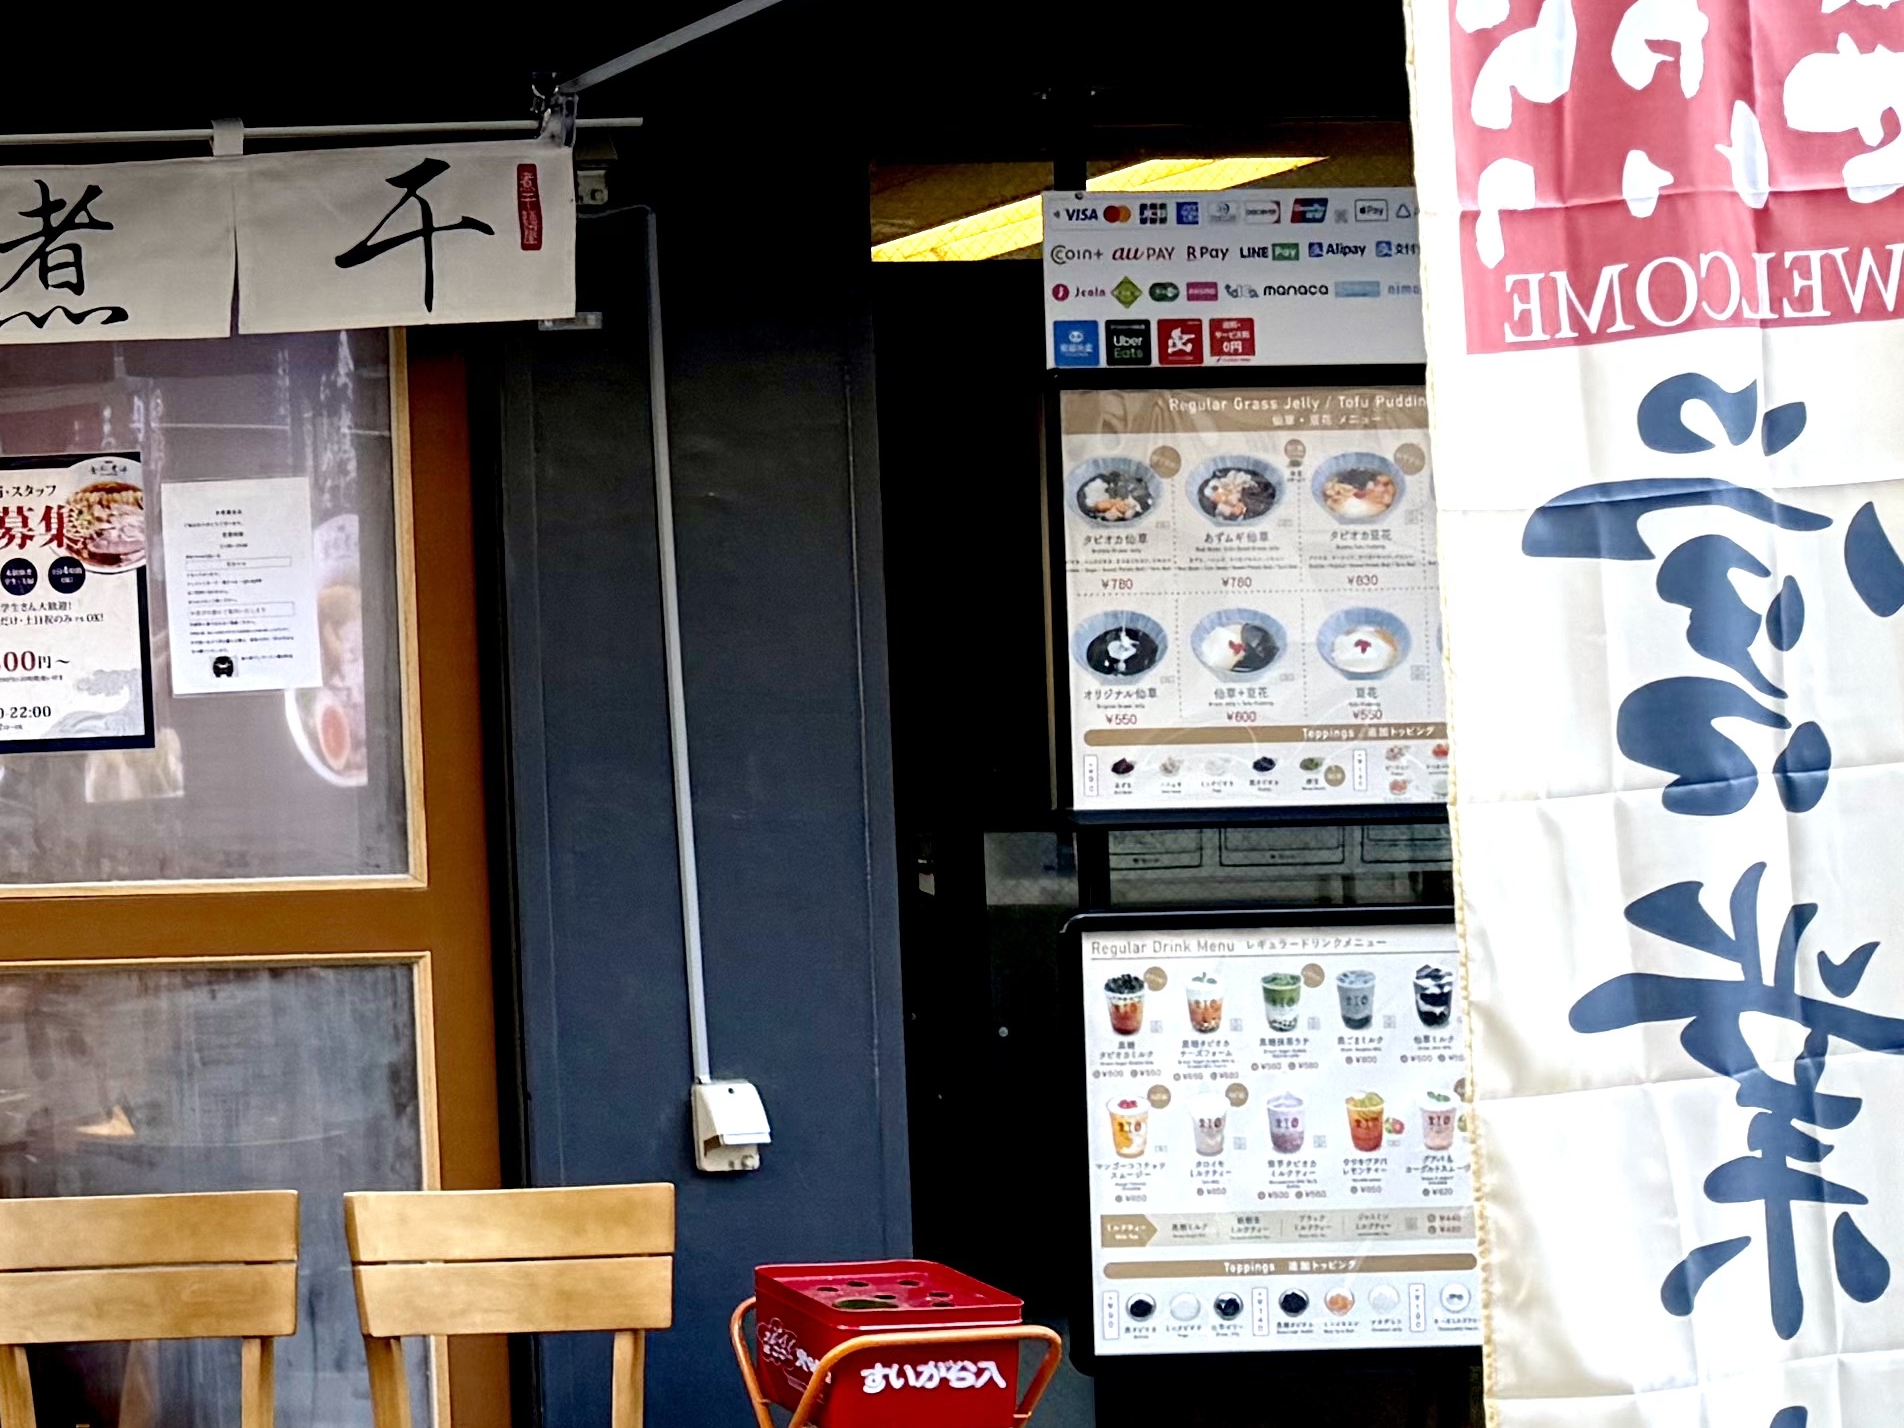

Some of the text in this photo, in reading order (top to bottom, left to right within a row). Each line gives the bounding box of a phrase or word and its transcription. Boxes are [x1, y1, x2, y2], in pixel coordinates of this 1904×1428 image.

[1065, 208, 1099, 222] VISA
[1239, 246, 1269, 259] LINE
[1263, 284, 1330, 297] manaca
[1113, 335, 1143, 347] Uber
[1168, 397, 1228, 414] Regular
[1233, 397, 1279, 411] Grass
[1283, 396, 1320, 411] Jelly
[1339, 395, 1370, 408] Tofu
[1091, 940, 1148, 958] Regular
[1152, 939, 1191, 954] Drink
[1196, 939, 1235, 954] Menu
[859, 1359, 1007, 1395] すいがら入
